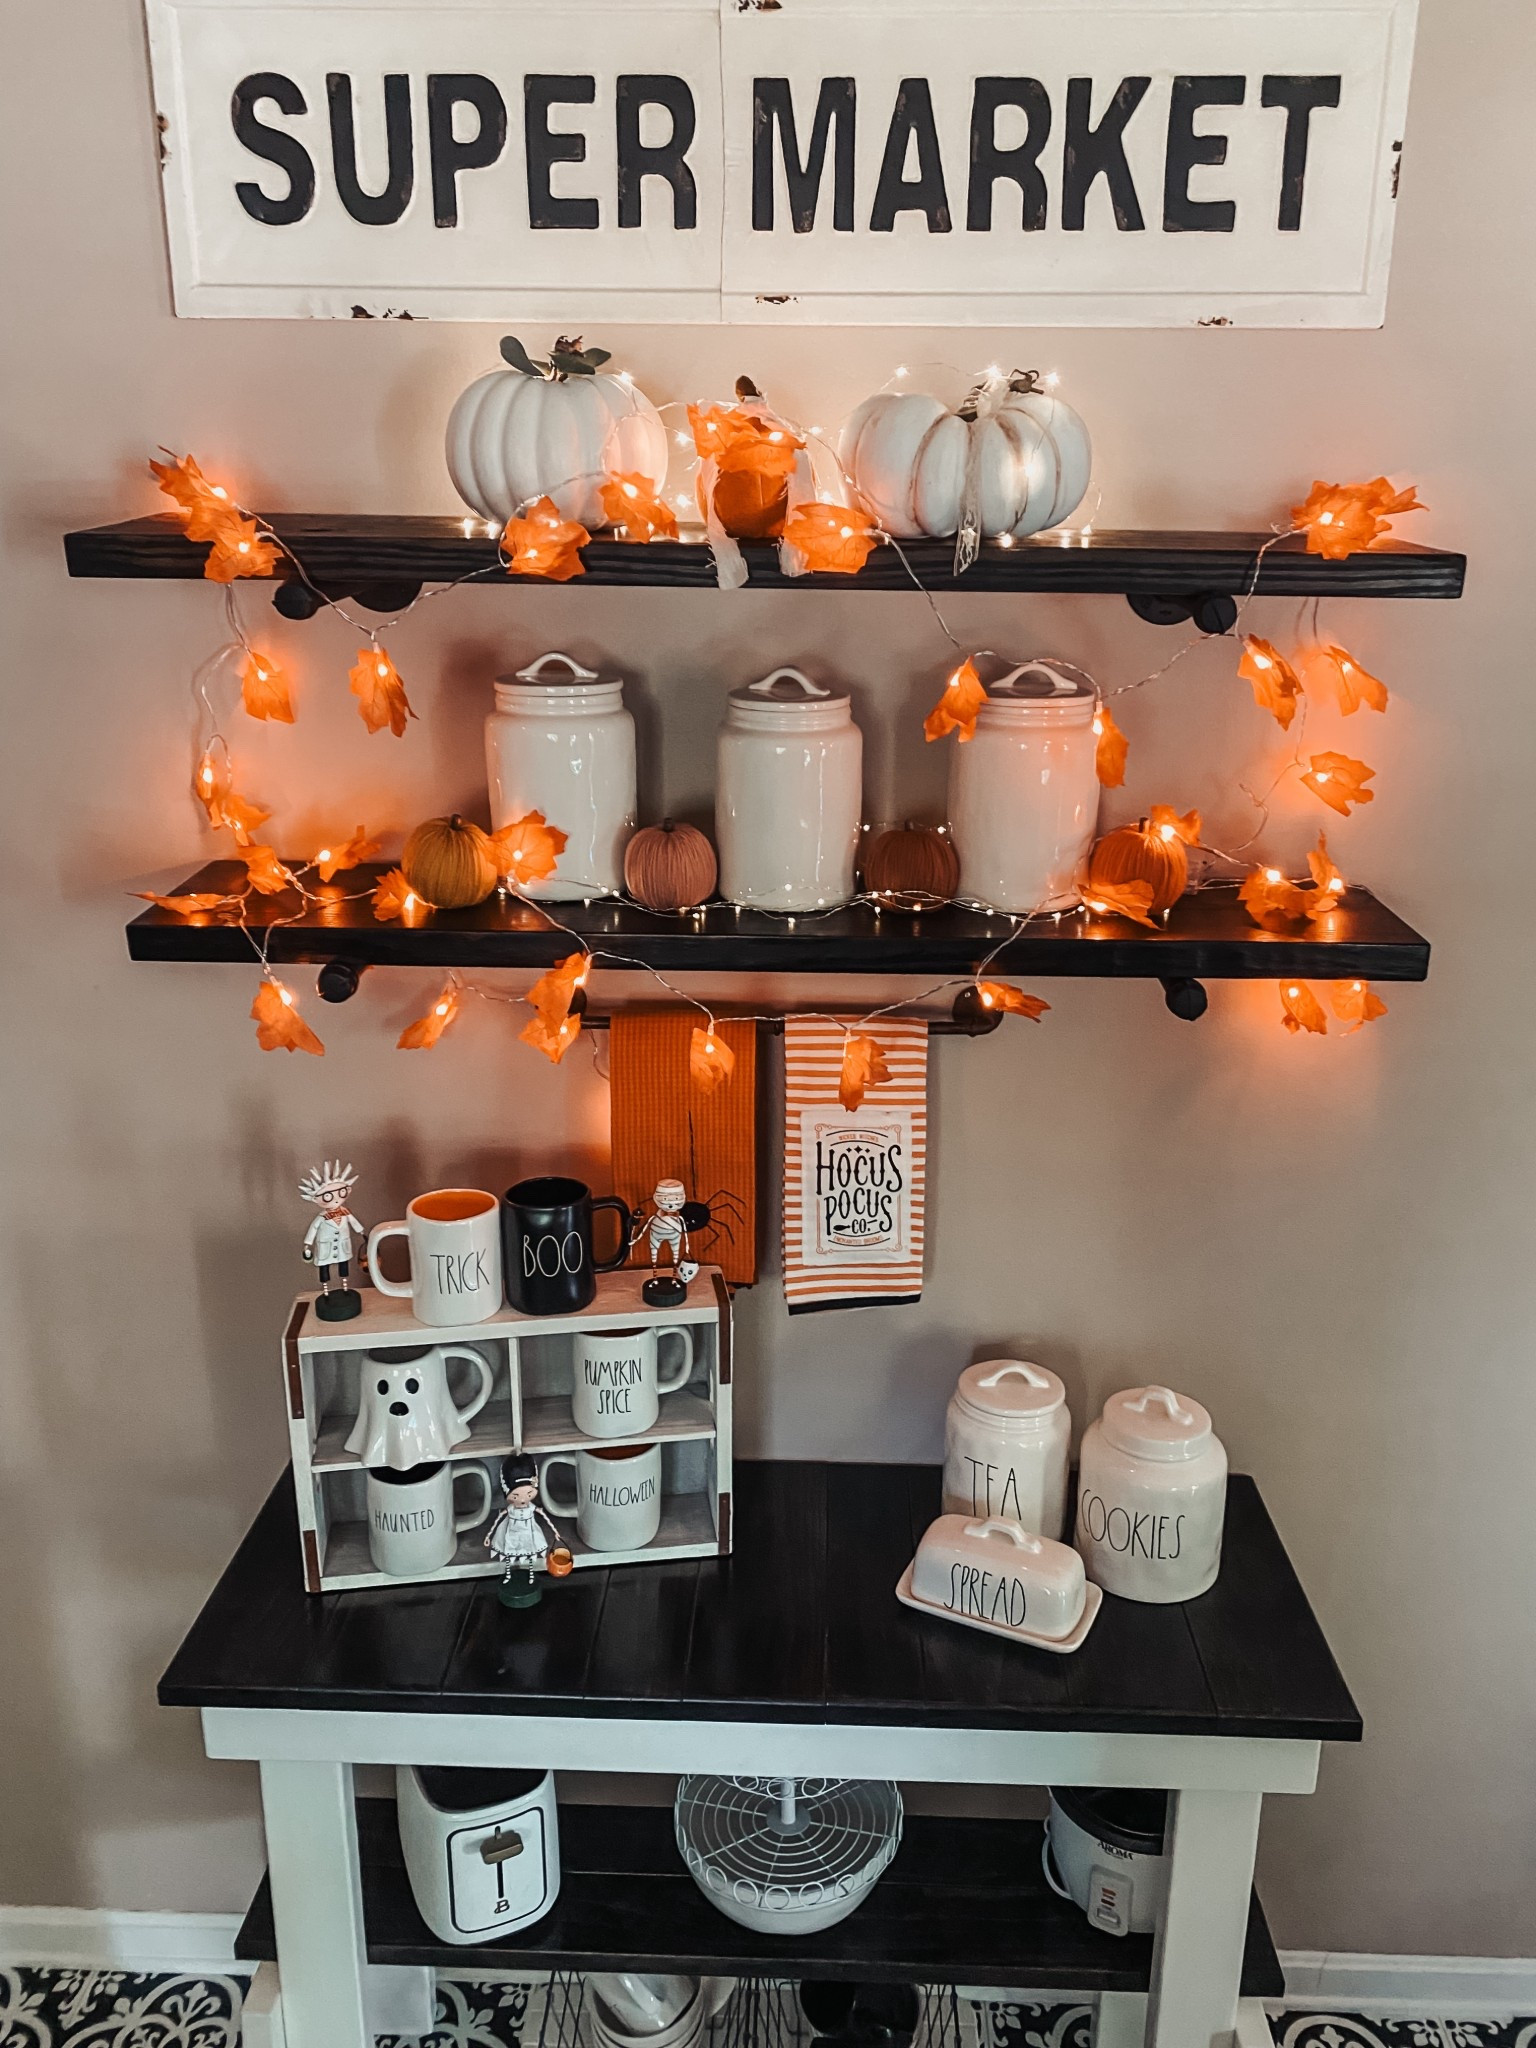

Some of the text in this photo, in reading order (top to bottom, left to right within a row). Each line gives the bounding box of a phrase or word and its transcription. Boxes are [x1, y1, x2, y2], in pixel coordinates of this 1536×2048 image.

[232, 72, 1341, 233] SUPER MARKET
[816, 1141, 902, 1195] HOCUS
[824, 1187, 892, 1236] POCUS
[851, 1219, 871, 1234] CO.
[430, 1248, 490, 1295] TRICK
[523, 1231, 583, 1277] BOO
[584, 1358, 642, 1386] PUMPKIN
[597, 1388, 632, 1414] SPICE
[589, 1476, 655, 1506] HALLOWEEN
[375, 1509, 434, 1533] HAUNTED
[1082, 1489, 1185, 1560] COOKIES
[944, 1563, 1026, 1627] SPREAD
[1097, 1841, 1133, 1860] AROMA
